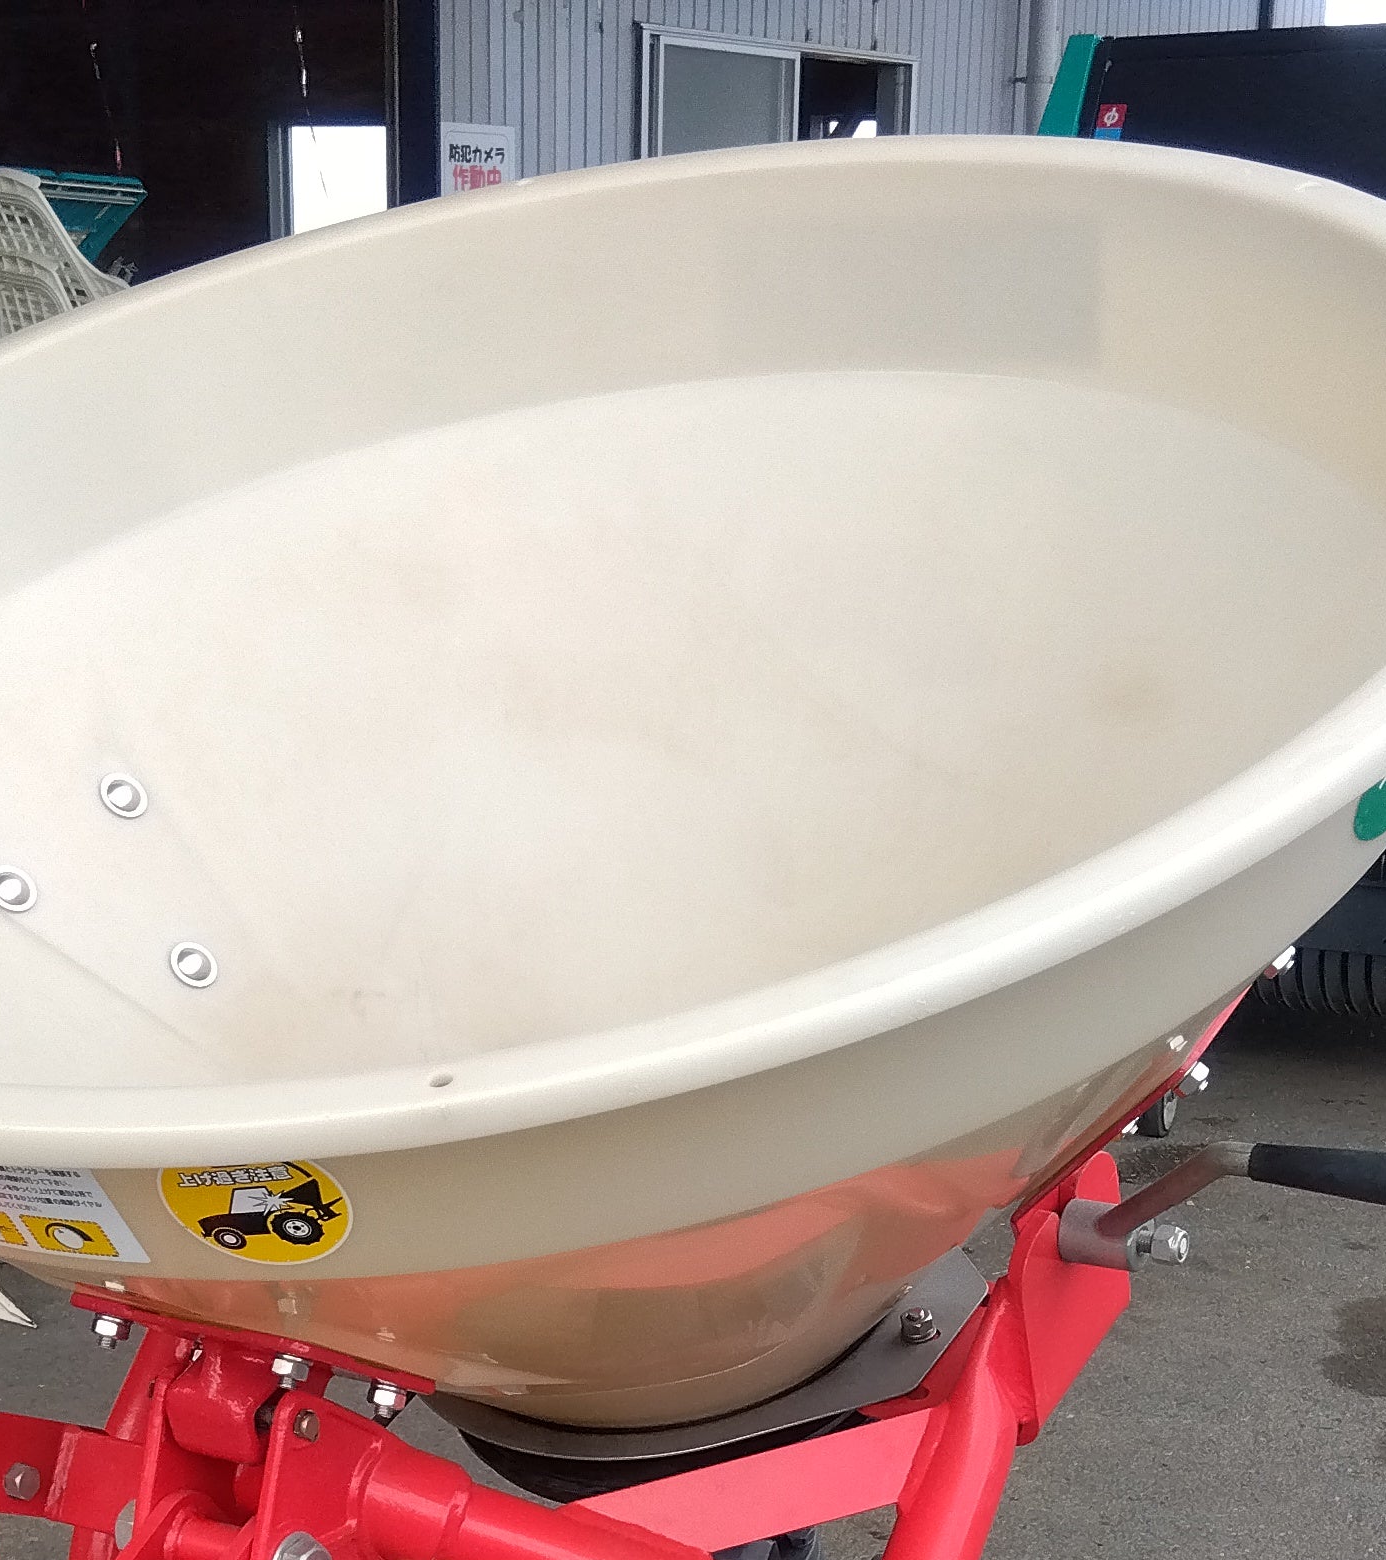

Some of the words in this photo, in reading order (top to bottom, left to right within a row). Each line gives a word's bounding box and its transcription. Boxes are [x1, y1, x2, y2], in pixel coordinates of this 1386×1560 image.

[449, 143, 505, 164] 防犯カメラ
[453, 164, 502, 191] 作動中
[178, 1164, 294, 1188] 上げ過ぎ注意
